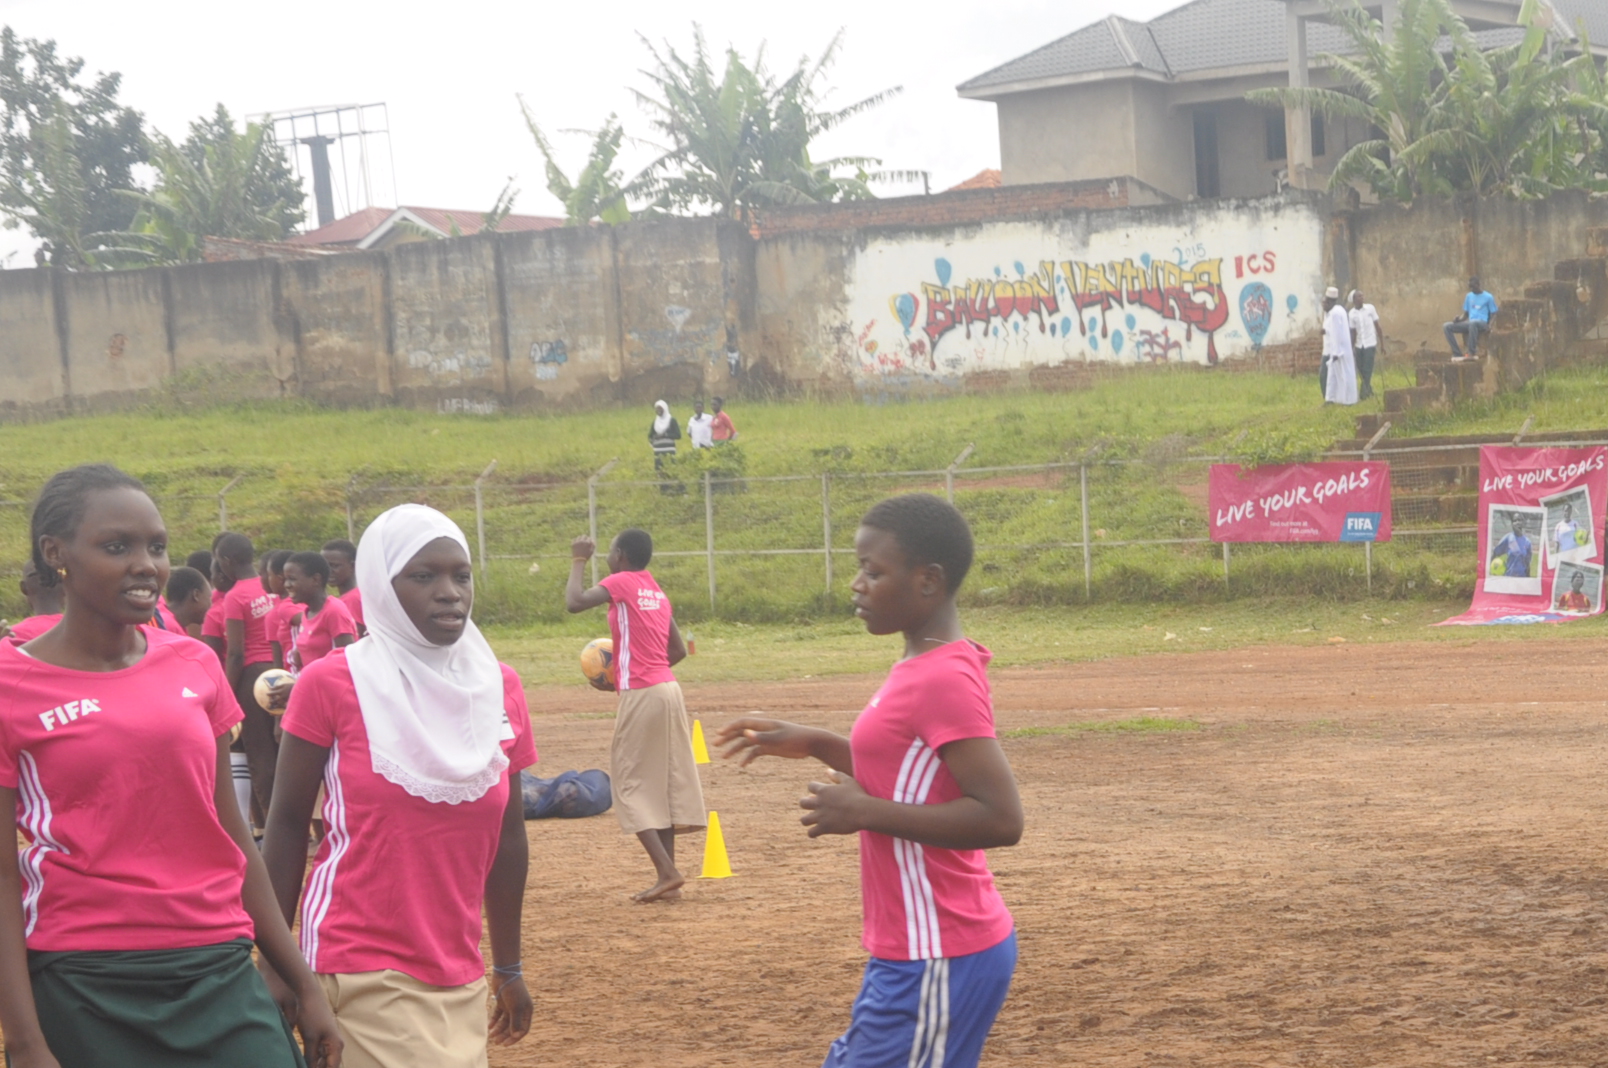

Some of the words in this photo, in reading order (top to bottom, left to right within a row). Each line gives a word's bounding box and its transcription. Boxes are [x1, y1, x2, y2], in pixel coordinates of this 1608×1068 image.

[1172, 243, 1206, 266] 2015
[1234, 251, 1276, 279] ICS
[1483, 474, 1513, 493] LIVE
[1518, 468, 1558, 490] YOUR
[1558, 455, 1604, 482] GOALS
[1216, 500, 1255, 527] LIVE
[1260, 486, 1312, 517] YOUR
[1313, 468, 1370, 504] GOALS
[1347, 518, 1374, 530] FIFA
[38, 698, 102, 732] FIFA
